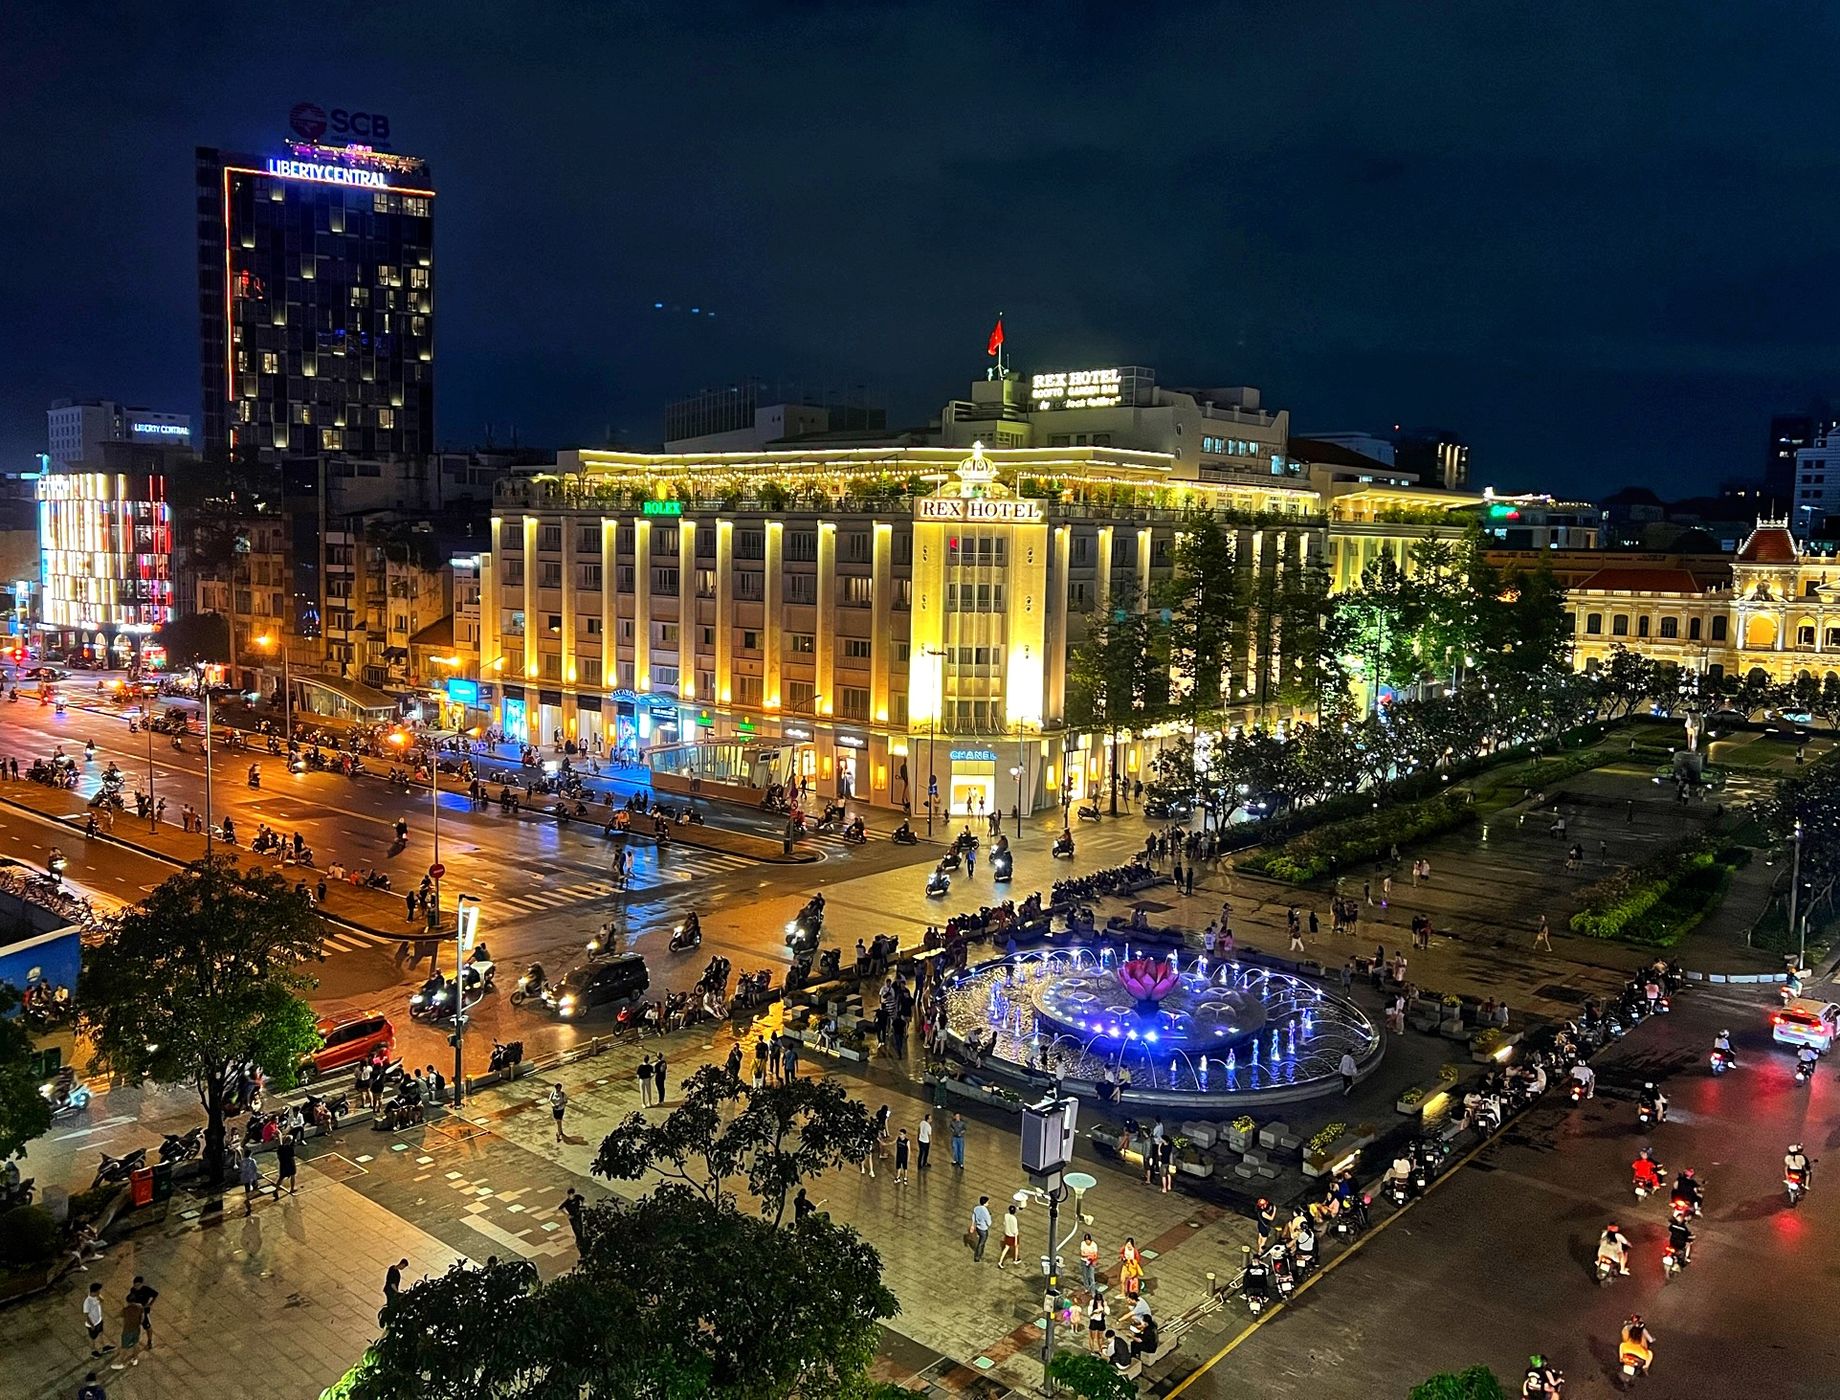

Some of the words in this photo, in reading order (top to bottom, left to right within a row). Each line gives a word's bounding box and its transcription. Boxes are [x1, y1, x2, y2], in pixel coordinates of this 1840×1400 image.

[330, 108, 390, 139] SCB
[269, 158, 323, 181] LIBERTY
[323, 165, 388, 188] CENTRAL
[1032, 373, 1067, 388] REX
[1068, 369, 1121, 386] HOTEL
[643, 501, 682, 515] ROLEX
[923, 501, 962, 516] REX
[969, 502, 1041, 518] HOTEL
[949, 750, 998, 761] CHANEL
